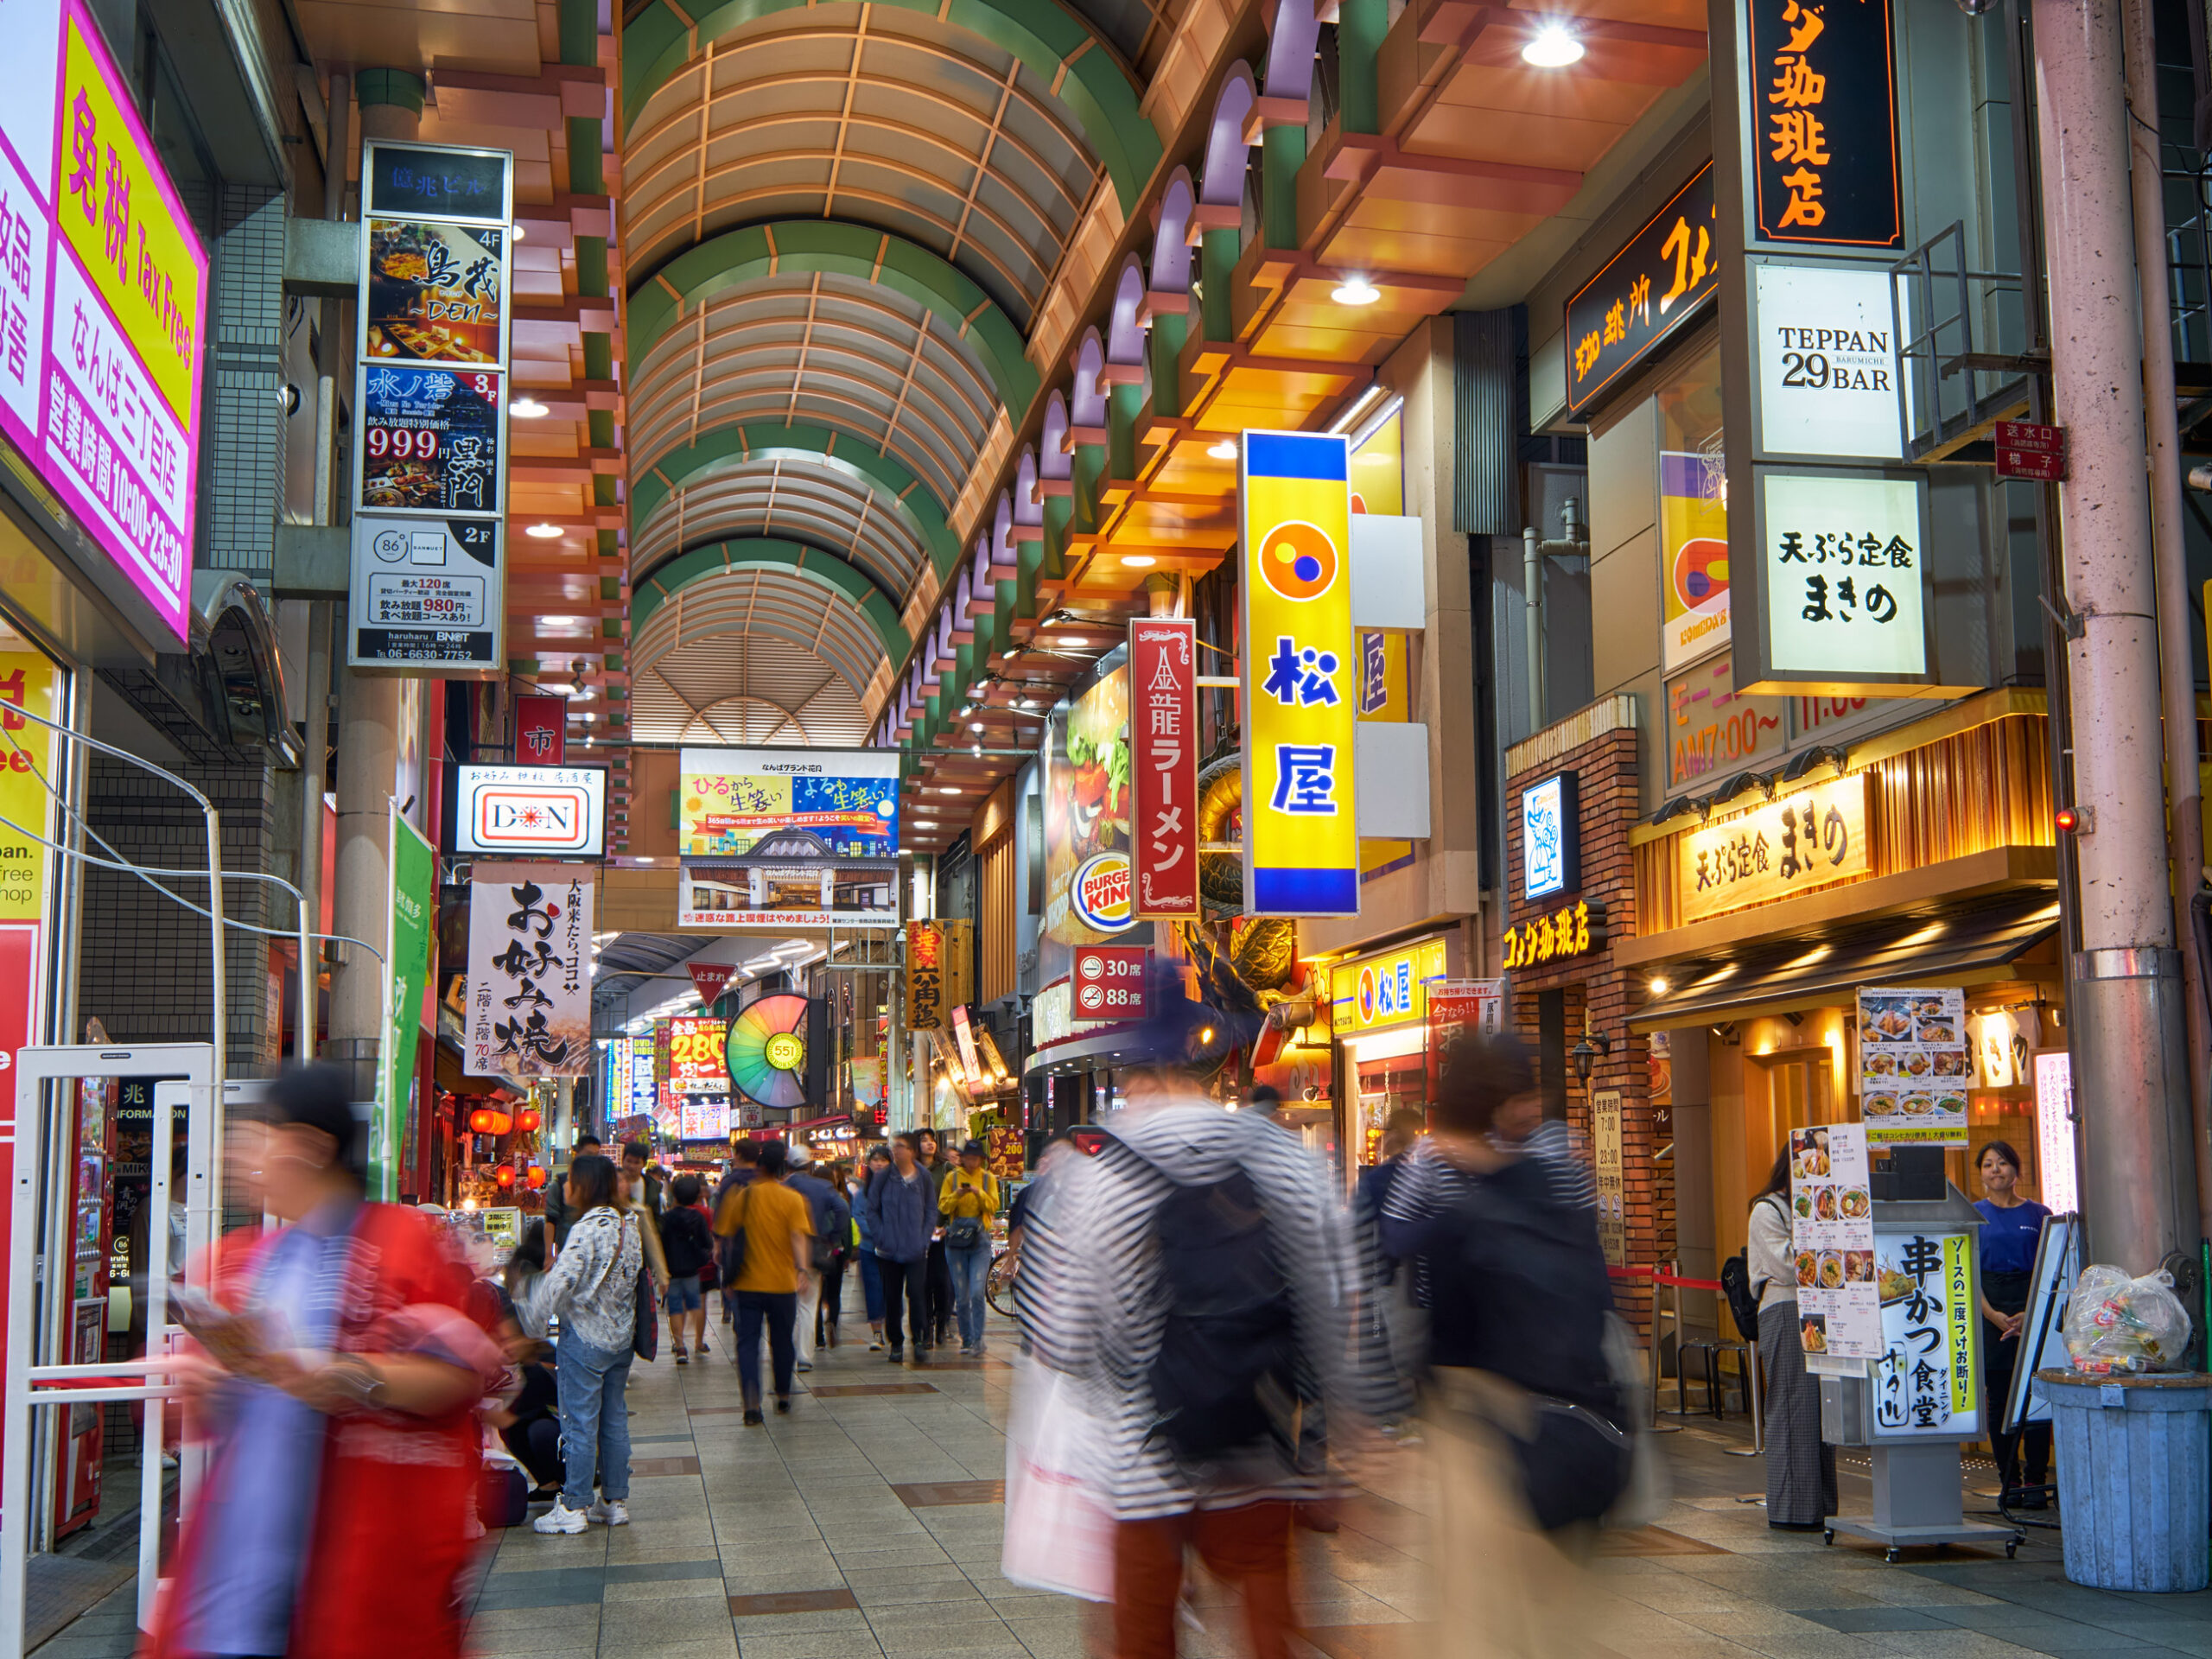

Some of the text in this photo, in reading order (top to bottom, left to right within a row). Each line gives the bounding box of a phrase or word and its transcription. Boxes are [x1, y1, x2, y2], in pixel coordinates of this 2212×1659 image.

[392, 166, 485, 197] 億兆ビル
[69, 85, 191, 370] 免税 Tax Free
[479, 231, 500, 247] 4F
[1660, 204, 1717, 315] コメ
[1575, 273, 1650, 383] 珈琲所
[1778, 327, 1888, 353] TEPPAN
[1782, 352, 1891, 391] 29 BAR
[368, 369, 496, 402] 水ノ砦 3F
[72, 298, 176, 505] なんば三丁目店
[367, 416, 450, 430] 飲み放題特別価格
[2006, 424, 2052, 441] 送水口
[48, 370, 182, 593] 営業時間 10:00-23:30
[448, 436, 486, 508] 黒門
[465, 527, 490, 543] 2F
[1779, 531, 1913, 569] 天ぷら定食
[402, 578, 451, 589] 最大120席
[1802, 574, 1897, 624] まきの
[380, 610, 470, 622] 食べ放題コースあり!
[389, 632, 429, 640] haruharu
[388, 649, 472, 660] 06-6630-7752
[1262, 635, 1341, 817] 松屋
[524, 726, 555, 756] 市
[762, 764, 822, 772] なんばグランド花月
[1147, 646, 1185, 872] 金龍ラーメン
[471, 772, 510, 782] お好み
[555, 772, 594, 785] 居酒屋
[693, 777, 753, 795] ひるから
[1780, 799, 1847, 880] まきの
[0, 847, 33, 859] an.
[1696, 830, 1770, 893] 天ぷら定食
[1084, 870, 1129, 895] BURGE
[565, 878, 582, 982] 大阪来たら、ココ
[694, 913, 830, 924] 迷惑な路上喫煙はやめましょう!
[1503, 899, 1590, 969] コメダ珈琲店
[491, 880, 569, 1065] お好み焼
[696, 971, 725, 982] 止まれ
[1106, 960, 1141, 976] 30席
[1106, 989, 1141, 1005] 88席
[1378, 960, 1411, 1016] 松屋
[1438, 987, 1492, 995] お持ち帰りできます。
[1433, 1001, 1475, 1023] 今なら!!
[671, 1020, 697, 1036] 全品
[775, 1046, 794, 1057] 551
[678, 1061, 716, 1077] 均一
[1596, 1099, 1620, 1114] 営業時間
[1600, 1116, 1615, 1132] 7:00
[1599, 1150, 1618, 1165] 23:00
[1599, 1176, 1622, 1190] 年中無休
[1900, 1236, 1944, 1428] 串かつ食堂
[1952, 1237, 1970, 1408] ソースの二度づけお断り!
[1938, 1367, 1949, 1426] ダイニング
